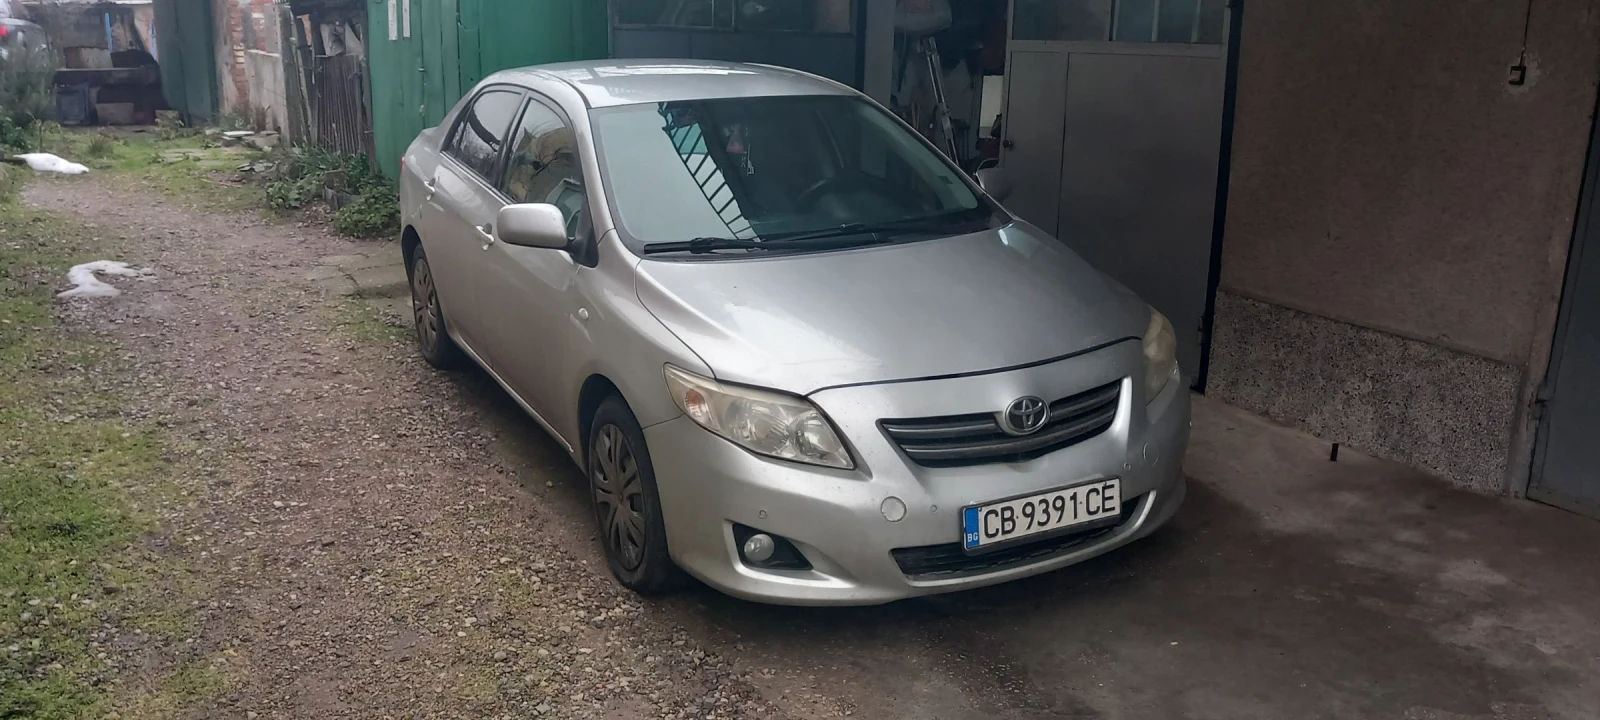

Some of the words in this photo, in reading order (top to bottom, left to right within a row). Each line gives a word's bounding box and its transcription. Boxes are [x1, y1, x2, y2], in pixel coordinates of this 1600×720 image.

[984, 505, 1016, 538] CB
[1021, 491, 1078, 530] 9391
[1086, 484, 1116, 516] CE
[967, 532, 978, 542] BG
